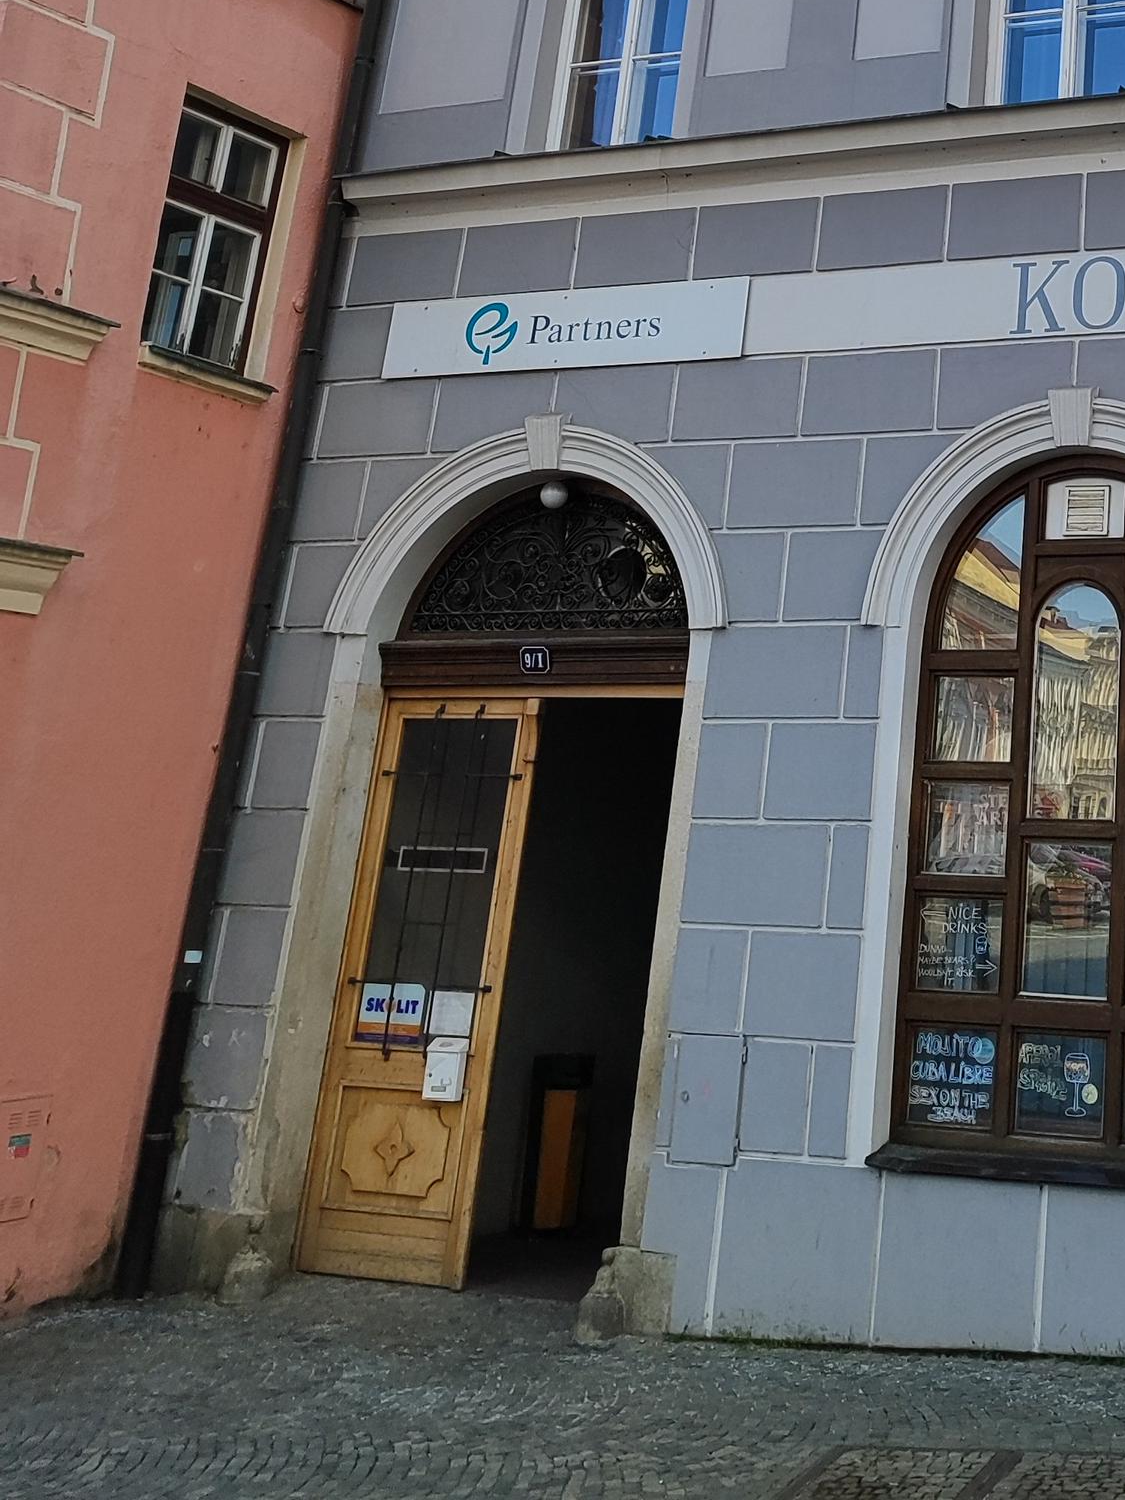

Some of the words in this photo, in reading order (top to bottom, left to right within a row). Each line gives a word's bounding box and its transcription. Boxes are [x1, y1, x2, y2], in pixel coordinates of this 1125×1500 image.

[525, 315, 661, 345] Partners
[524, 652, 544, 668] 9/I
[948, 902, 982, 920] NICE
[942, 920, 988, 934] DRINKS
[916, 1032, 983, 1059] MOJITO
[961, 1088, 991, 1109] THE
